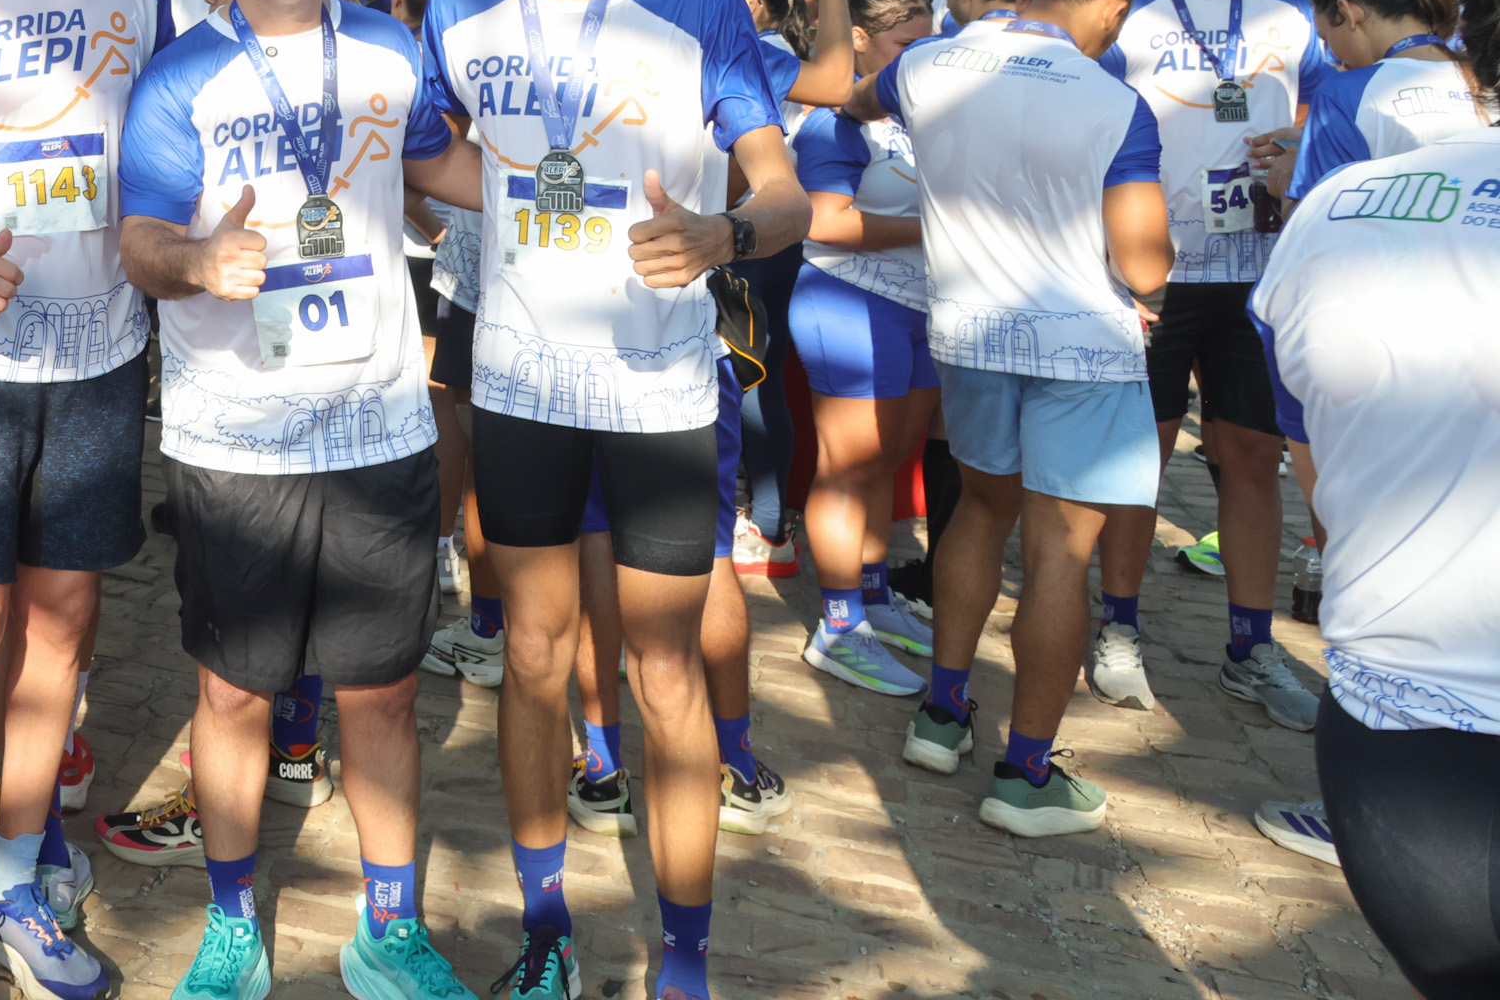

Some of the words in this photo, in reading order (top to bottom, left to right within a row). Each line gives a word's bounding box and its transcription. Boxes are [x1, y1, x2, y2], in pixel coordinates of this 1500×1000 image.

[1006, 55, 1054, 69] ALEPI
[543, 166, 567, 174] ALEPI
[7, 165, 97, 207] 1143
[1461, 215, 1486, 226] DO
[515, 208, 612, 254] 1139
[304, 268, 324, 276] ALEPI
[299, 290, 349, 332] 01
[279, 762, 314, 779] CORRE
[374, 879, 389, 908] ALEPI
